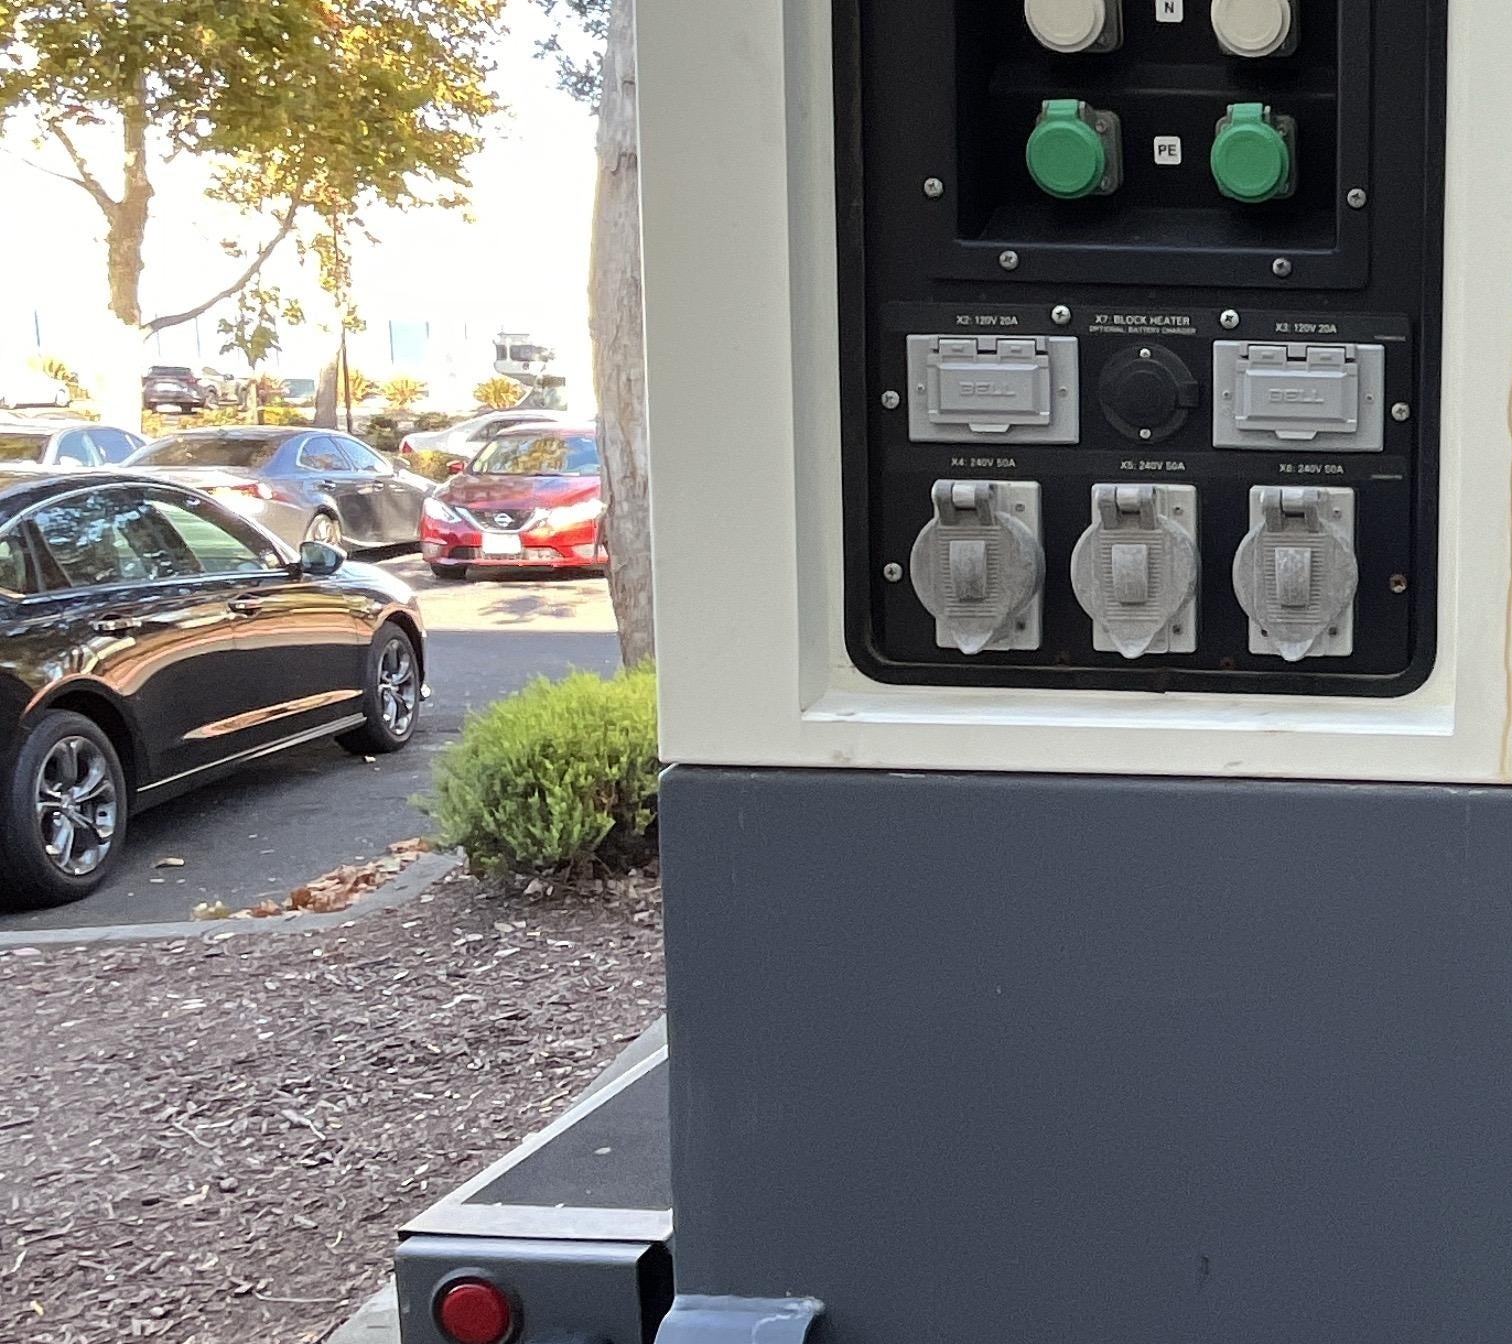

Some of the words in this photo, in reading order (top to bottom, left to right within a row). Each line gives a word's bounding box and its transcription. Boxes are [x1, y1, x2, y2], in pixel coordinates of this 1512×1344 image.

[1163, 1, 1175, 14] N
[1158, 144, 1177, 157] PE
[974, 315, 998, 326] 120V
[999, 315, 1018, 326] 20A
[1113, 314, 1147, 325] BLOCK
[1149, 315, 1190, 326] HEATER
[1294, 323, 1316, 334] 120V
[1318, 323, 1337, 334] 20A
[959, 381, 1016, 397] BELL
[1268, 387, 1324, 404] BELL
[970, 457, 994, 468] 240V
[1139, 460, 1163, 471] 240V
[1297, 464, 1322, 474] 240V
